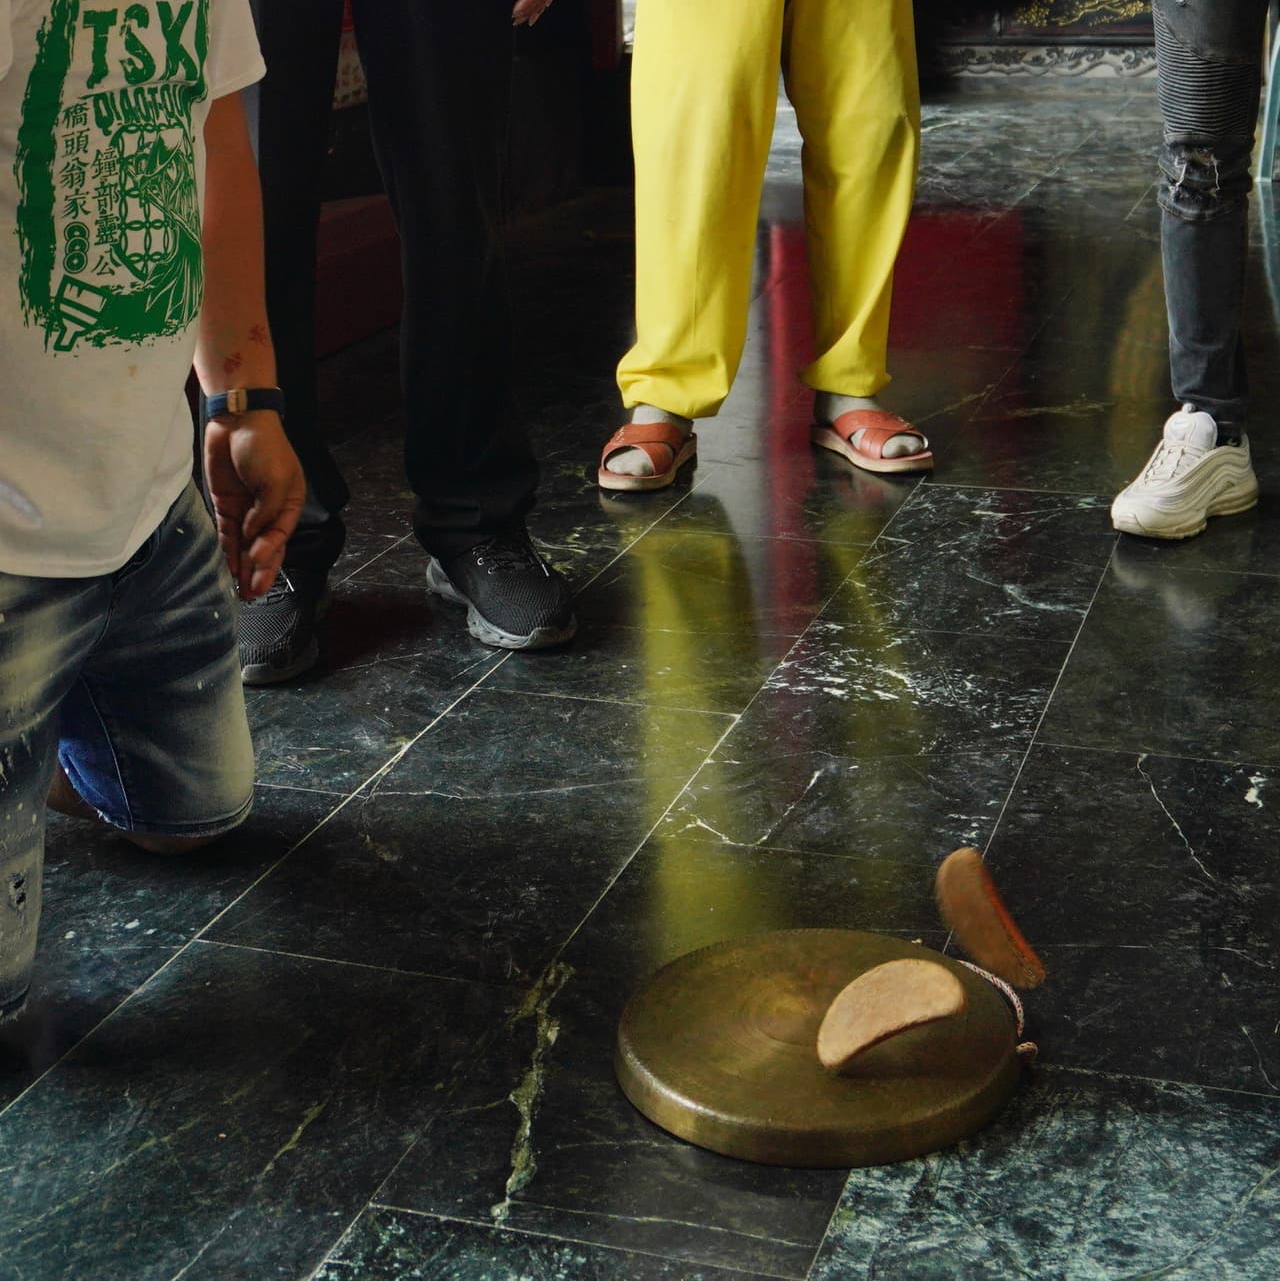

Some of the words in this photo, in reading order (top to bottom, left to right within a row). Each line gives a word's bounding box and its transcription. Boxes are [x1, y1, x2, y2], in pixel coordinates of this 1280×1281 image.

[81, 0, 199, 89] TSX
[59, 101, 91, 220] 橋頭翁家
